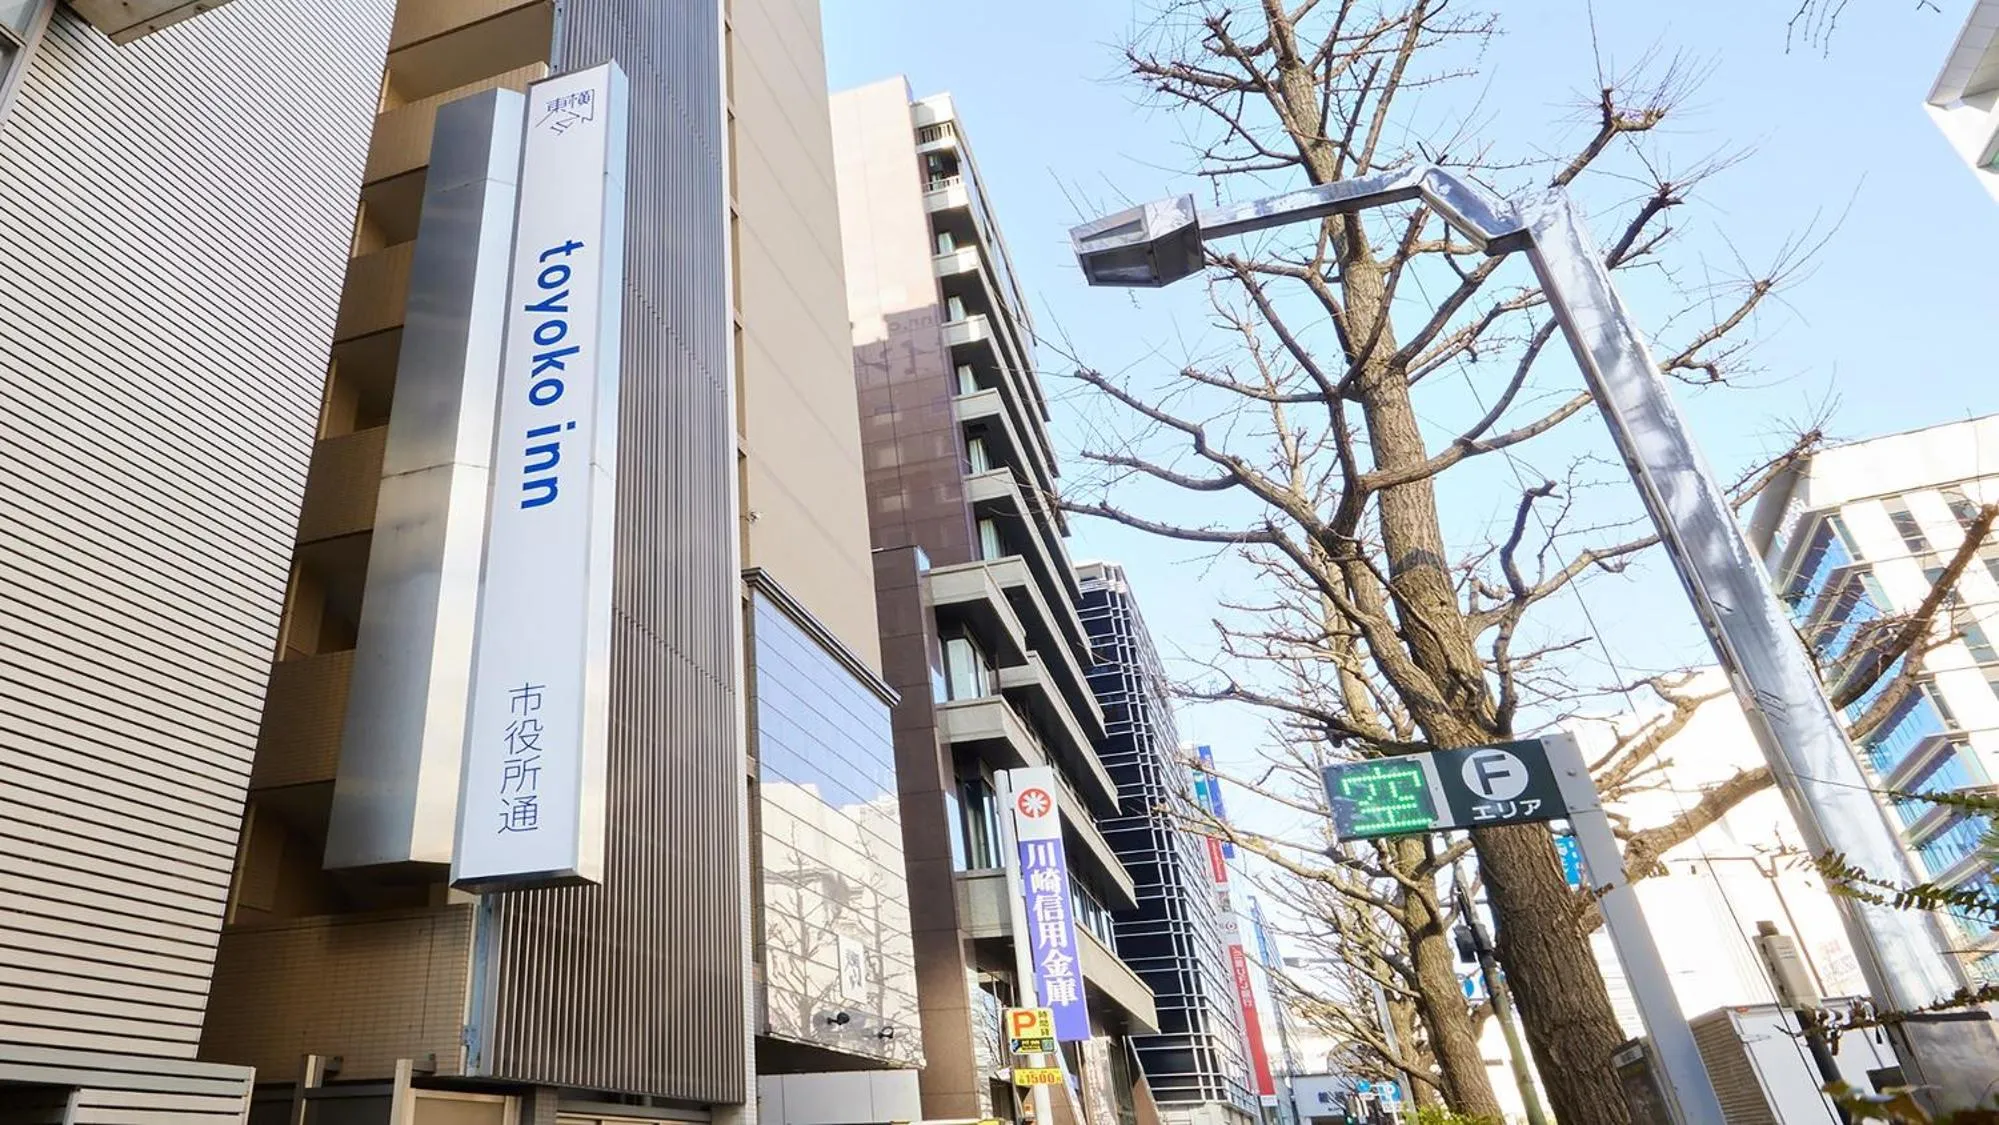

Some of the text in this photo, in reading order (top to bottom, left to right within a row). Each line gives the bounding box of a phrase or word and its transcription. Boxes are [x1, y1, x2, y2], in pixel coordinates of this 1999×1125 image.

[520, 241, 583, 509] toyoko inn
[497, 682, 545, 835] 市役所通
[1472, 753, 1511, 796] F
[1340, 766, 1433, 832] 空
[1471, 798, 1542, 821] エリア
[1027, 842, 1078, 1008] 川崎信用金庫
[1012, 1010, 1037, 1038] P
